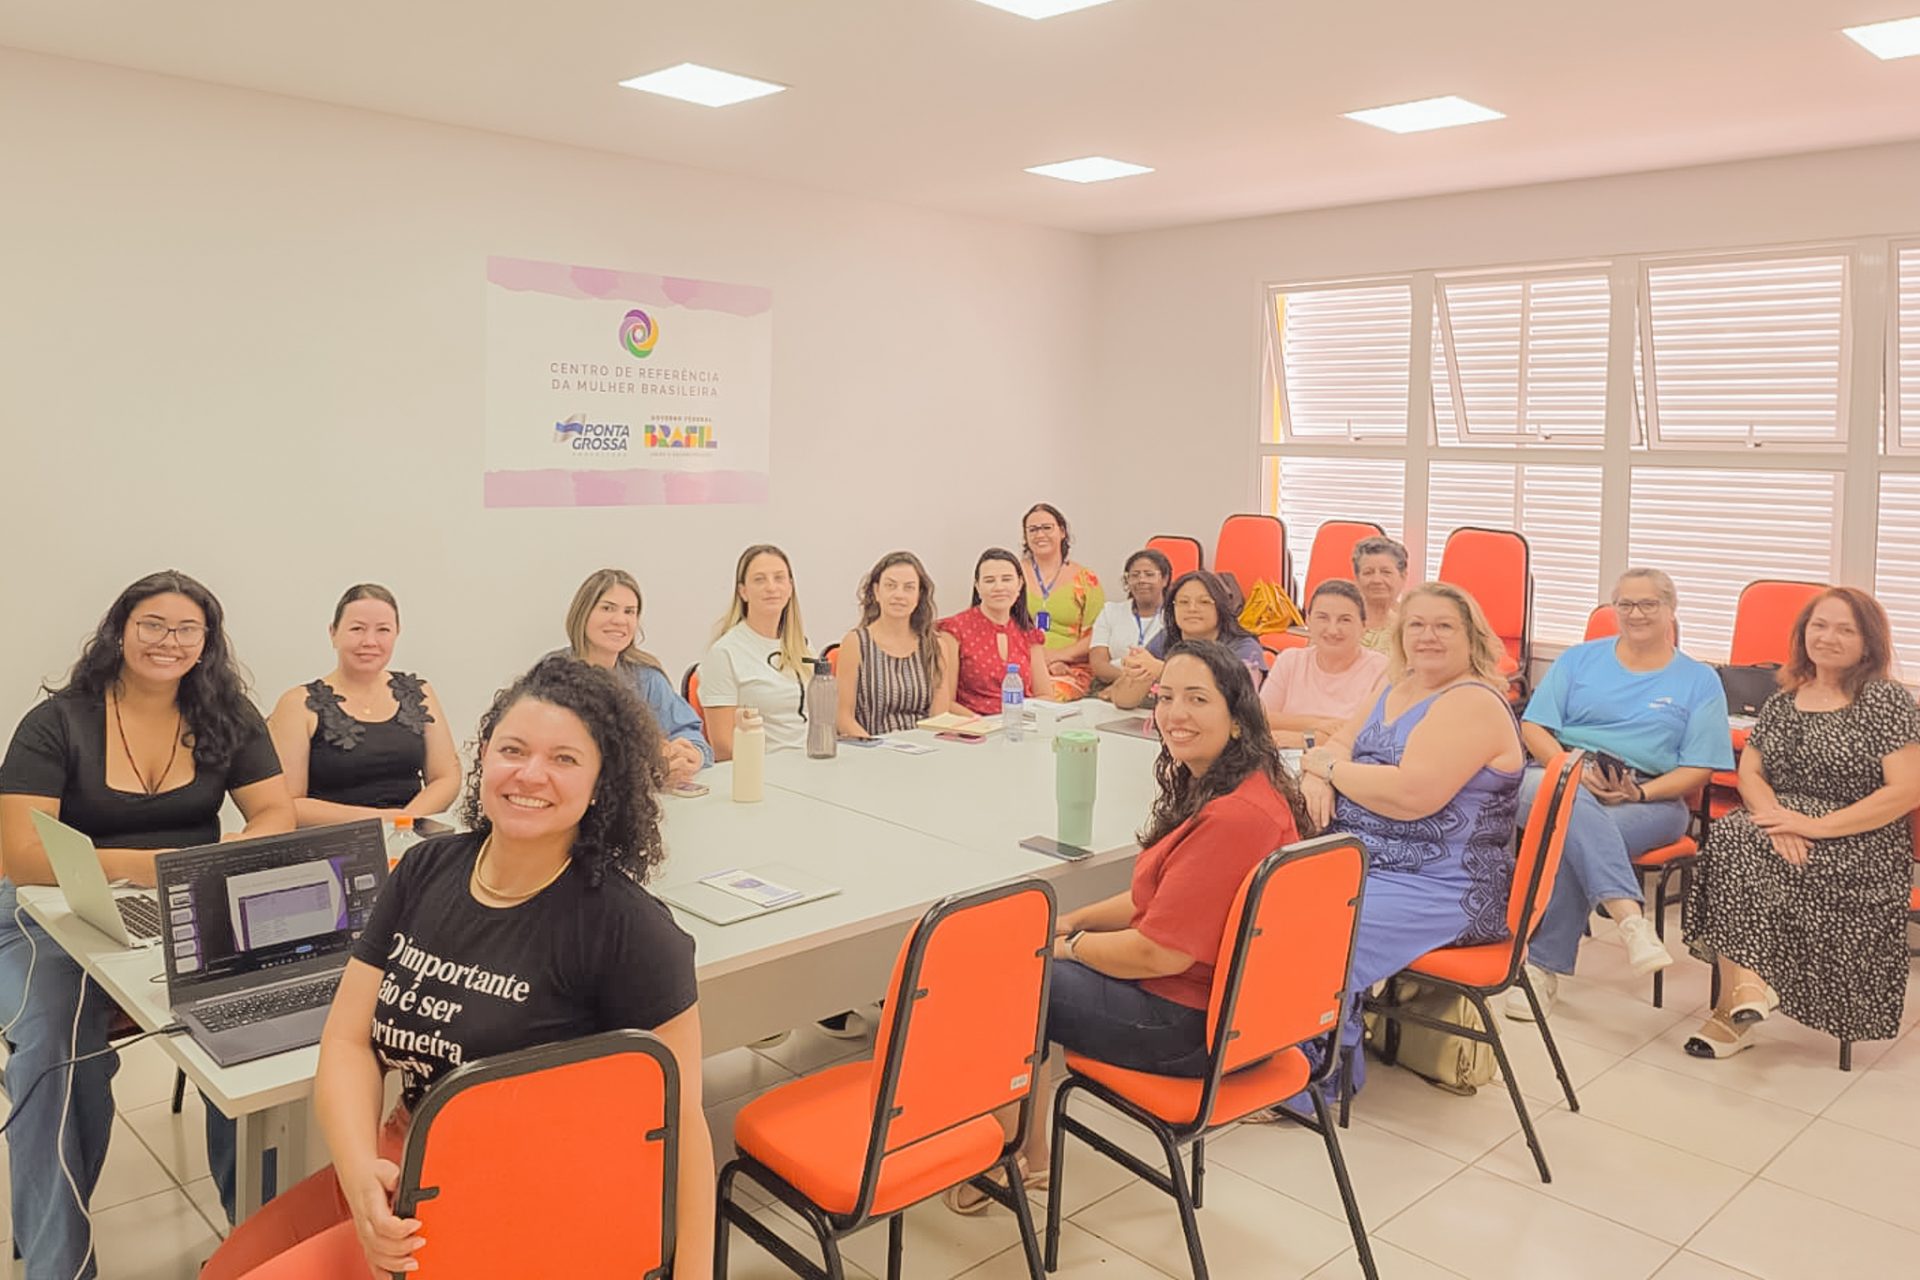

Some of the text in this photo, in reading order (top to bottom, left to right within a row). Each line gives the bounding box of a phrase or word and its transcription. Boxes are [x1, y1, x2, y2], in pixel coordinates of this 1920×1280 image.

[550, 363, 720, 382] CENTRO DE REFERÊNCIA
[551, 379, 718, 397] DA MULHER BRASILEIRA
[584, 424, 630, 437] PONTA
[572, 437, 628, 451] GROSSA
[398, 936, 531, 1003] importante
[378, 972, 463, 1023] ão é ser
